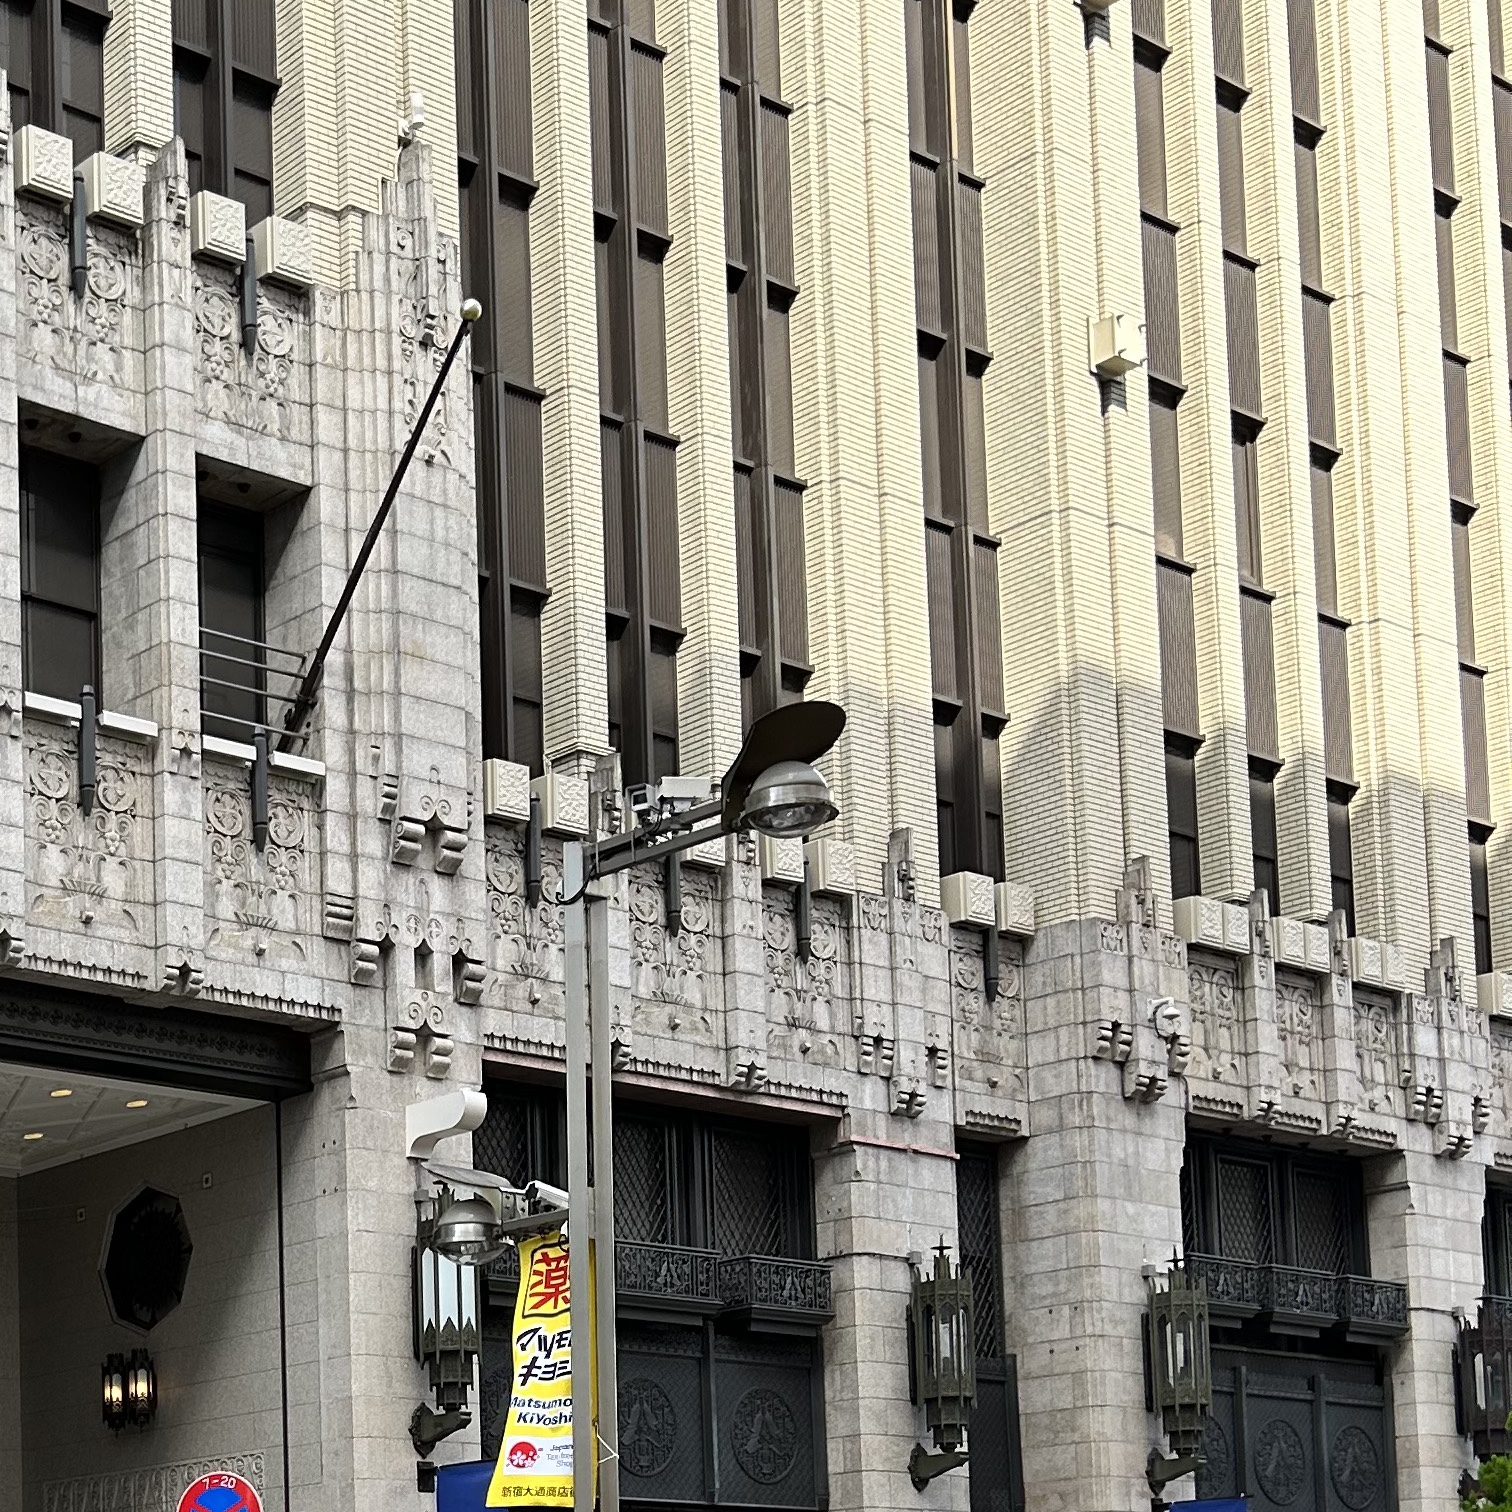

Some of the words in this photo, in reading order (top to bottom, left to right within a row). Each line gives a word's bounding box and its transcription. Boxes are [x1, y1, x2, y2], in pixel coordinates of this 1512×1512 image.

[527, 1251, 570, 1311] 薬
[516, 1326, 572, 1359] マツモ
[510, 1396, 572, 1409] Matsumo
[202, 1475, 236, 1490] 7-20
